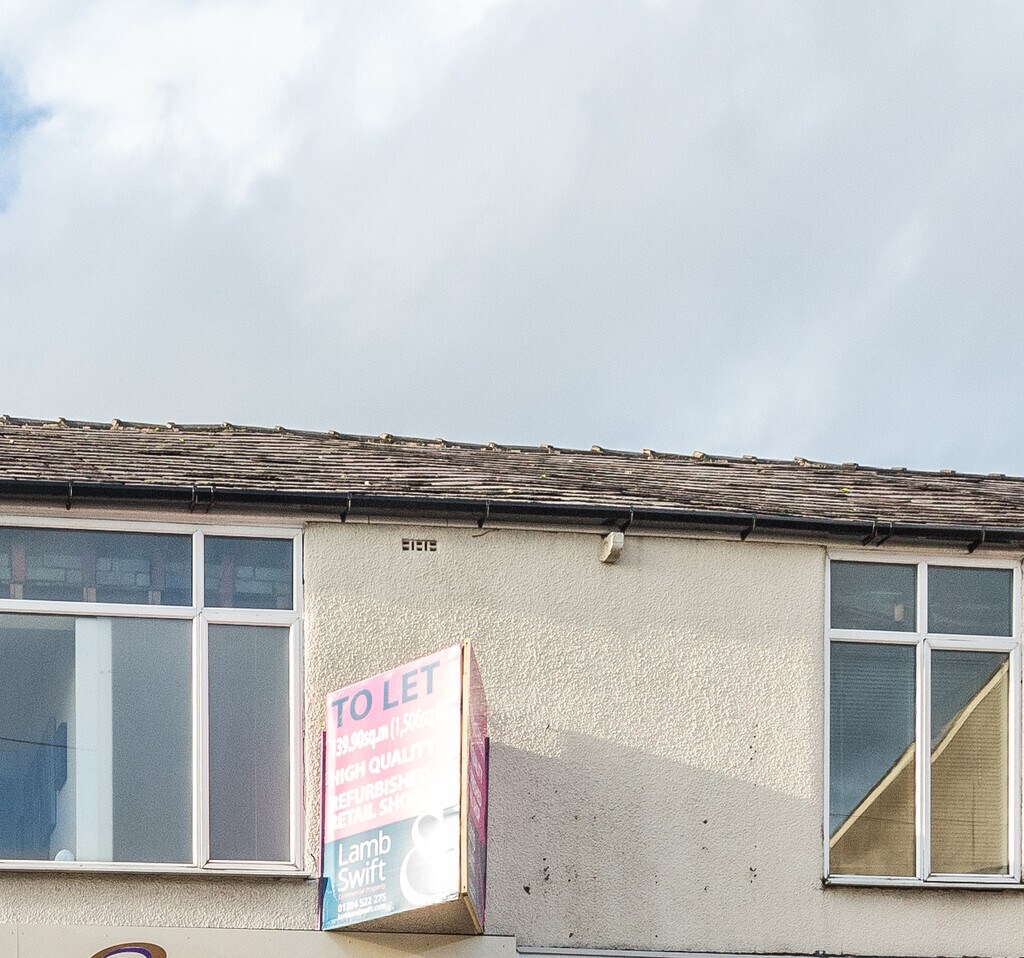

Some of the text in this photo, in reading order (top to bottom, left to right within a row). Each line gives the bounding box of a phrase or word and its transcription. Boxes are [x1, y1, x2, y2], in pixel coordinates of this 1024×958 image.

[332, 660, 441, 728] TO LET
[368, 736, 437, 774] QUALITY
[329, 803, 377, 830] RETAIL
[338, 830, 391, 867] Lamb
[337, 856, 386, 892] Swift
[359, 896, 373, 908] 522
[373, 893, 387, 904] 275
